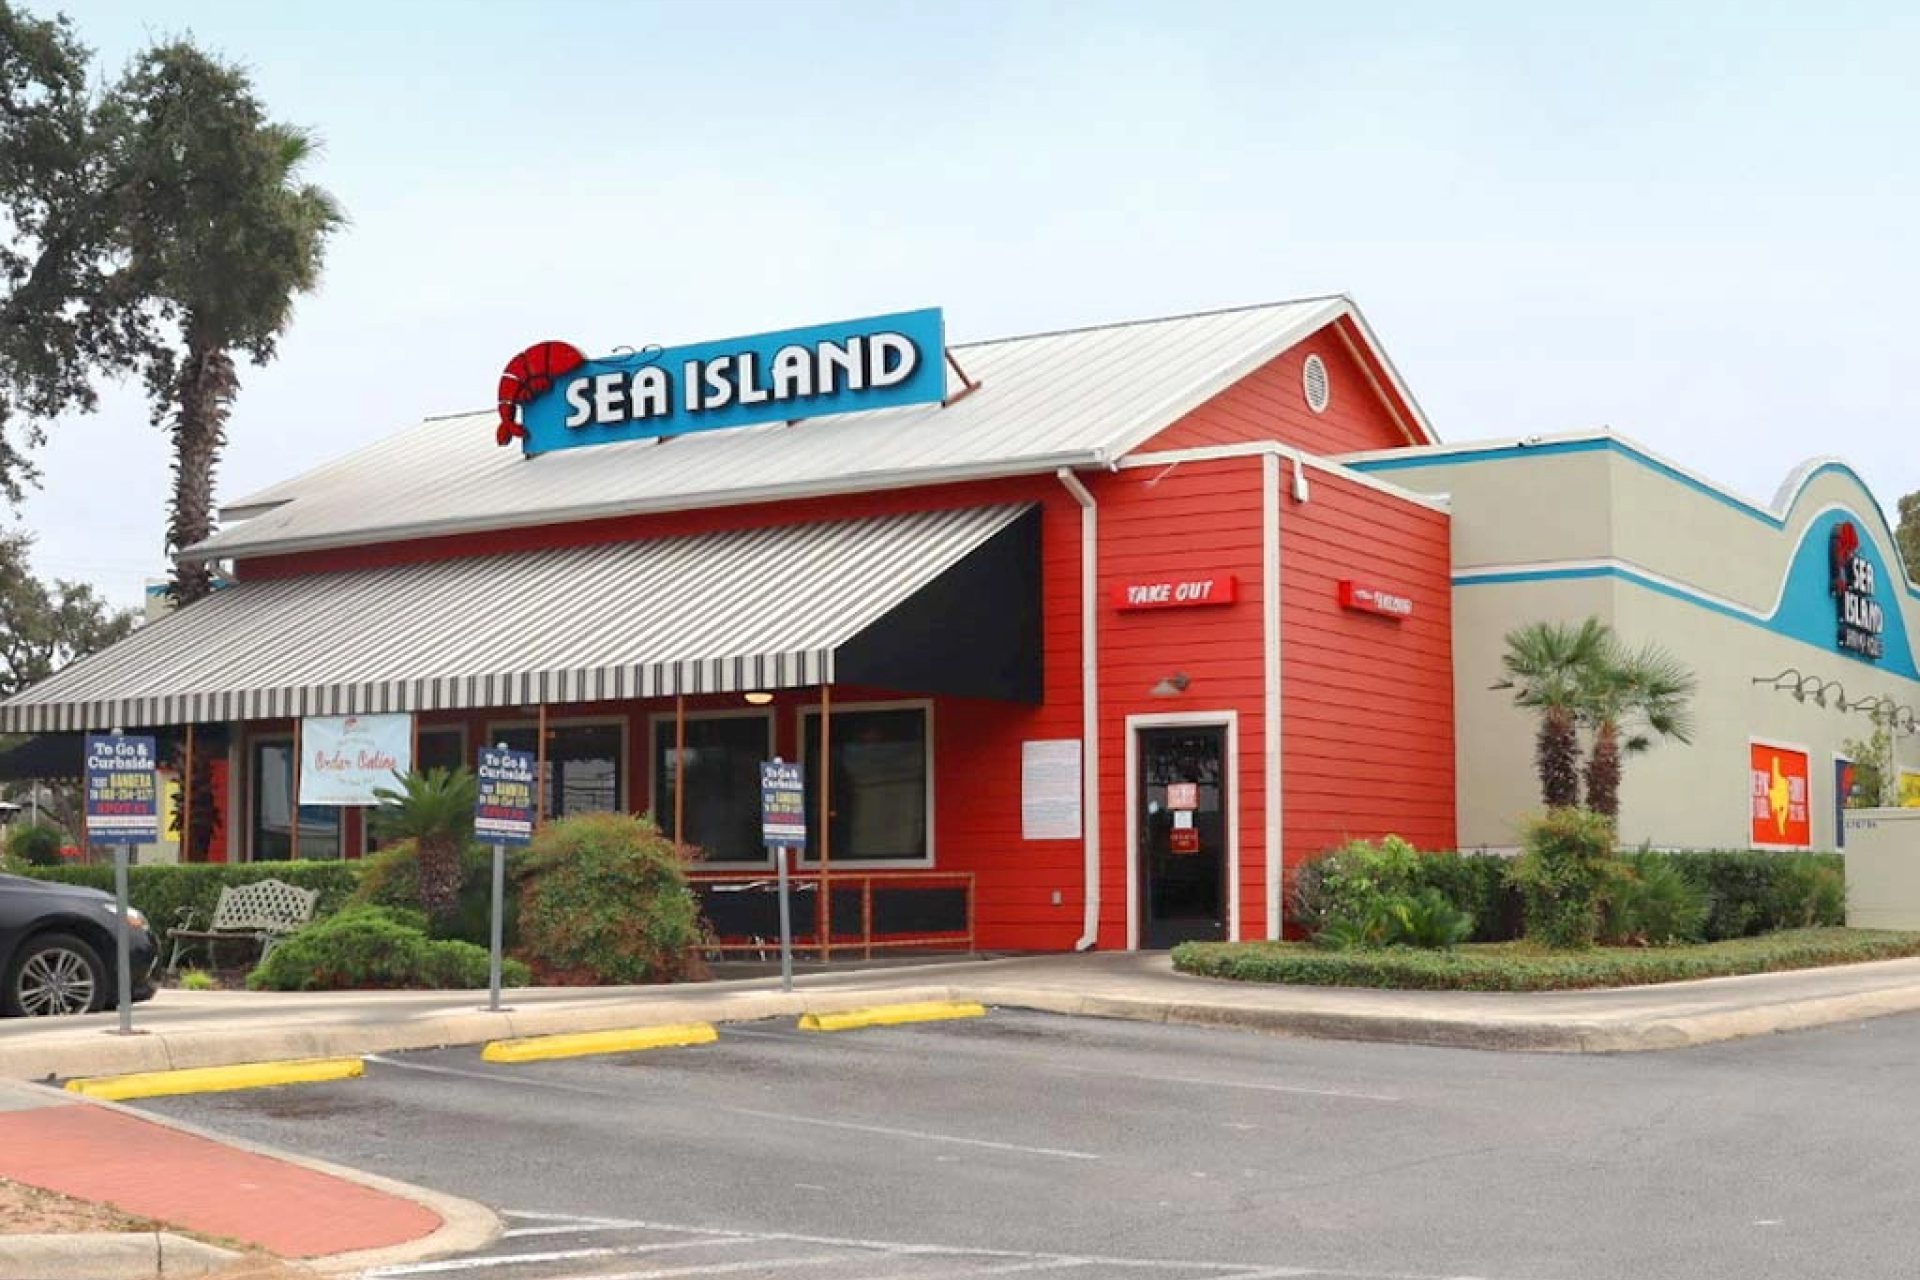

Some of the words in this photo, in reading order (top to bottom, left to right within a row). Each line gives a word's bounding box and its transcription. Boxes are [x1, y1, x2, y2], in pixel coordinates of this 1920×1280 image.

[564, 364, 669, 430] SEA
[684, 331, 919, 412] ISLAND
[1852, 556, 1875, 595] SEA
[1127, 583, 1172, 604] TAKE
[1175, 580, 1214, 601] OUT
[1844, 590, 1884, 635] ISLAND
[93, 742, 114, 756] To
[115, 742, 135, 756] Go
[136, 742, 150, 756] &
[314, 750, 352, 771] Order
[357, 749, 397, 770] Online
[87, 755, 156, 771] Curbside
[485, 753, 500, 767] To
[501, 756, 518, 769] Go
